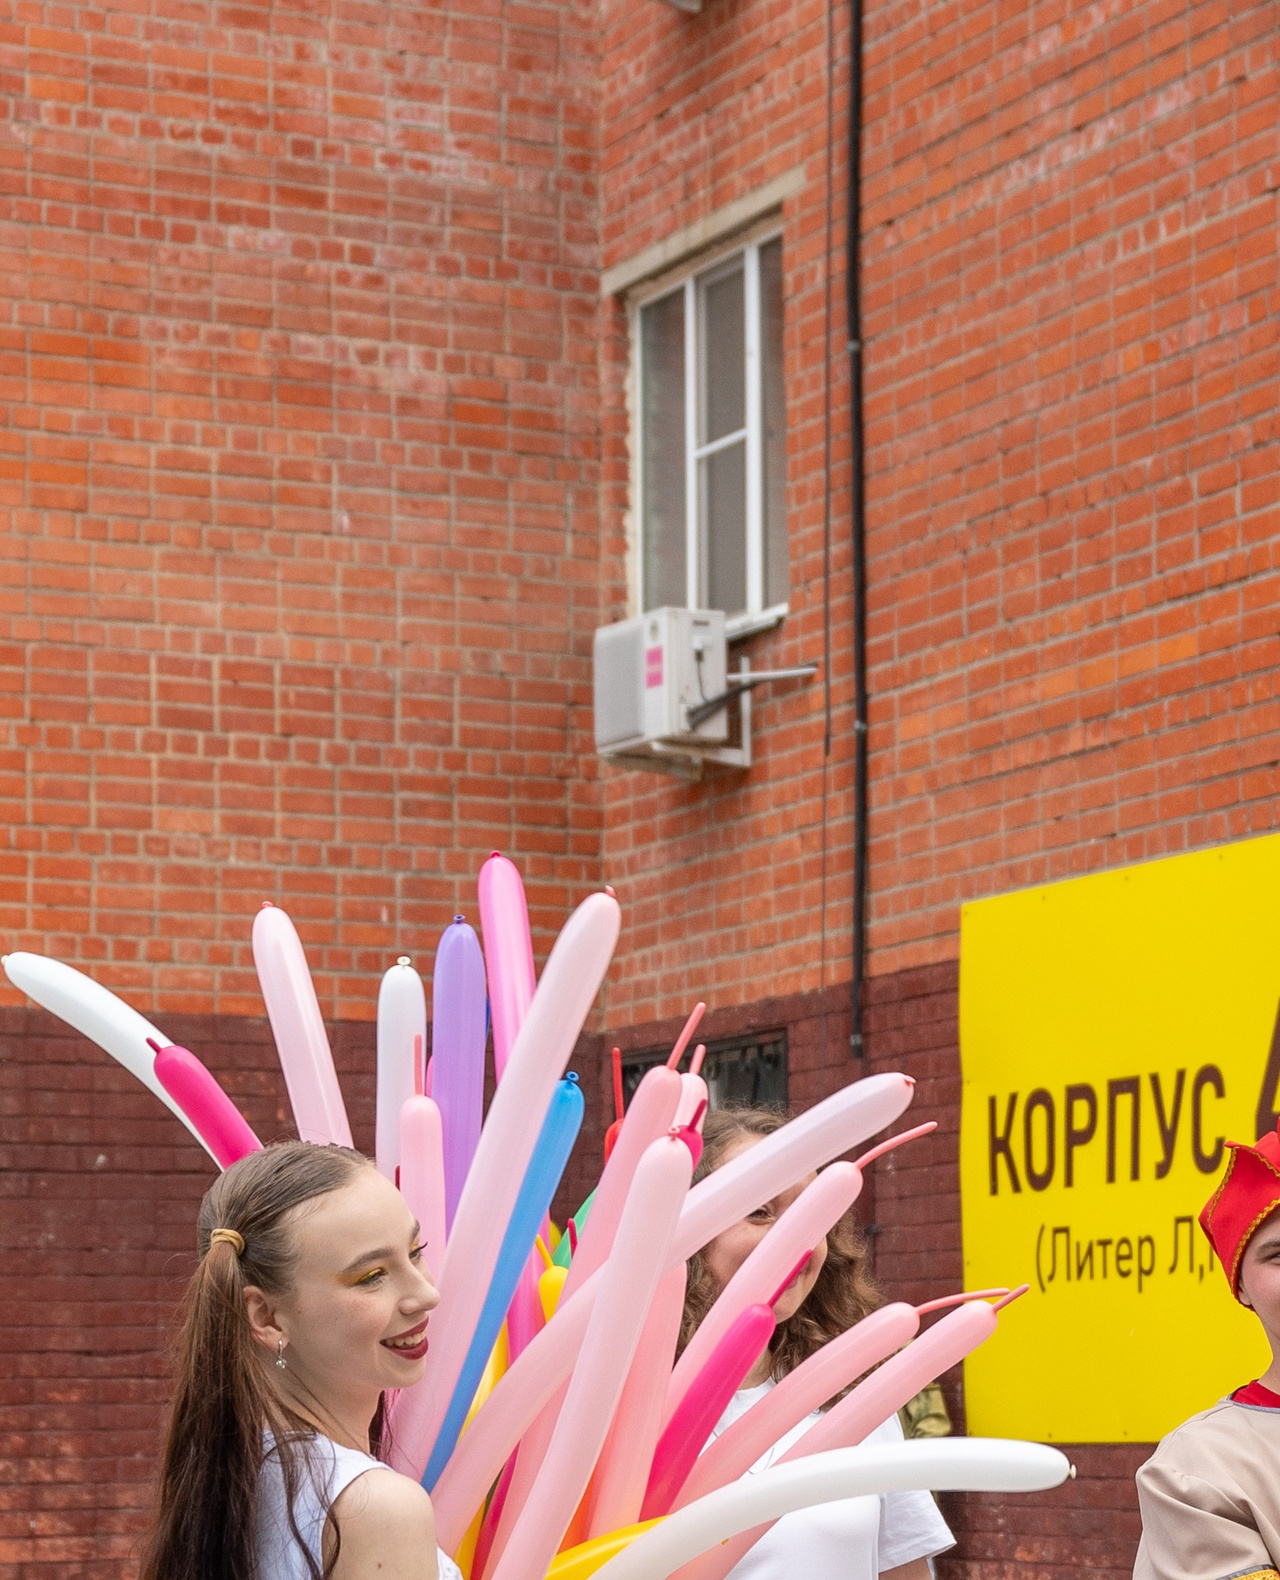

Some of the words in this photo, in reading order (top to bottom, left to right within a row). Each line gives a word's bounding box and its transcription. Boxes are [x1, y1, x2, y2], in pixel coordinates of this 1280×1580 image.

[988, 1063, 1226, 1196] КОРПУС
[1036, 1223, 1155, 1293] (Литер
[1168, 1214, 1215, 1284] Л,
